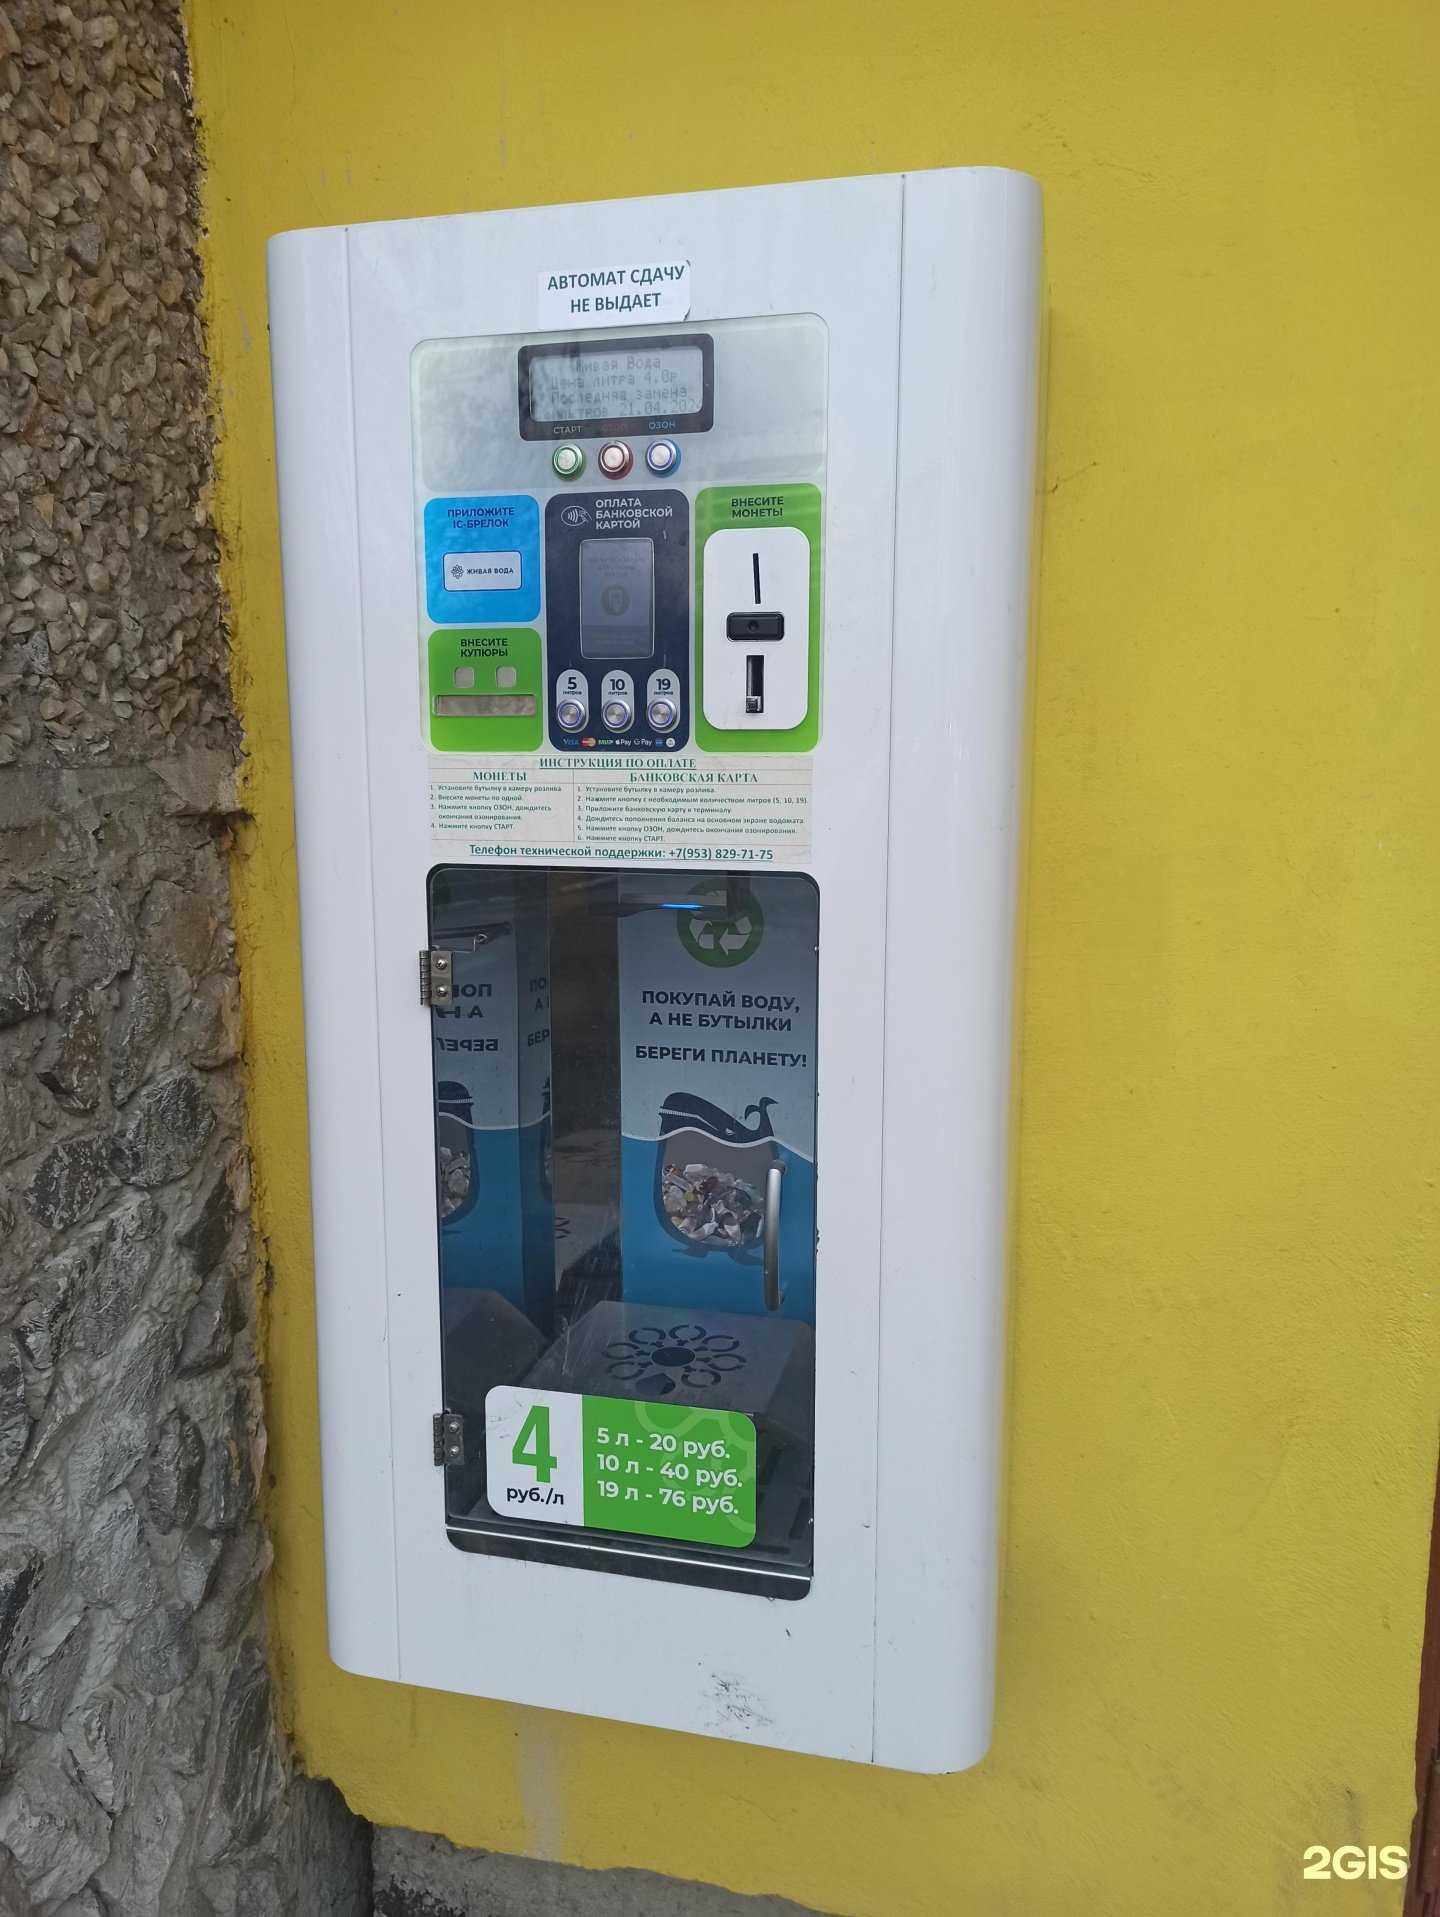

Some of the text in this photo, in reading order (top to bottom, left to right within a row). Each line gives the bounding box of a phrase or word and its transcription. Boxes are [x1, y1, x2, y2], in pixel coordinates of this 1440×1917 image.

[547, 265, 685, 290] АВТОМАТ СДАЧУ
[570, 292, 661, 313] НЕ ВЫДАЕТ
[553, 425, 582, 434] СТАРТ
[648, 420, 676, 430] ОЗОН
[596, 498, 642, 509] ОПЛАТА
[731, 496, 784, 508] ВНЕСИТЕ
[447, 507, 515, 518] ПРИЛОЖИТЕ
[595, 507, 673, 519] БАНКОВСКОЙ
[731, 507, 784, 519] МОНЕТЫ
[595, 518, 641, 530] КАРТОЙ
[466, 567, 514, 575] ЖИВАЯ ВОДА
[460, 637, 508, 648] ВНЕСИТЕ
[460, 647, 509, 658] КУПЮРЫ
[567, 676, 578, 690] 5
[609, 678, 626, 690] 10
[655, 678, 671, 690] 19
[620, 738, 632, 746] Pay
[539, 758, 696, 769] ИНСТРУКЦИЯ ПО ОПЛАТЕ
[473, 771, 527, 781] МОНЕТЫ
[629, 772, 758, 783] БАНКОВСКАЯ КАРТА
[469, 844, 773, 860] Телефон технической поддержки: +7(953) 829-71-75
[641, 990, 801, 1014] ПОКУПАЙ ВОДУ,
[649, 1011, 792, 1032] А НЕ БУТЫЛКИ
[635, 1045, 808, 1068] БЕРЕГИ ПЛАНЕТУ!
[511, 1405, 558, 1484] 4
[596, 1427, 610, 1445] 5
[615, 1433, 629, 1447] л
[649, 1434, 677, 1453] 20
[683, 1441, 731, 1460] руб.
[596, 1454, 620, 1472] 10
[625, 1460, 639, 1475] л
[659, 1462, 689, 1481] 40
[696, 1470, 743, 1488] руб.
[506, 1486, 565, 1505] руб./л
[596, 1481, 619, 1499] 19
[624, 1487, 638, 1502] л
[658, 1489, 686, 1508] 76
[692, 1496, 739, 1515] руб.
